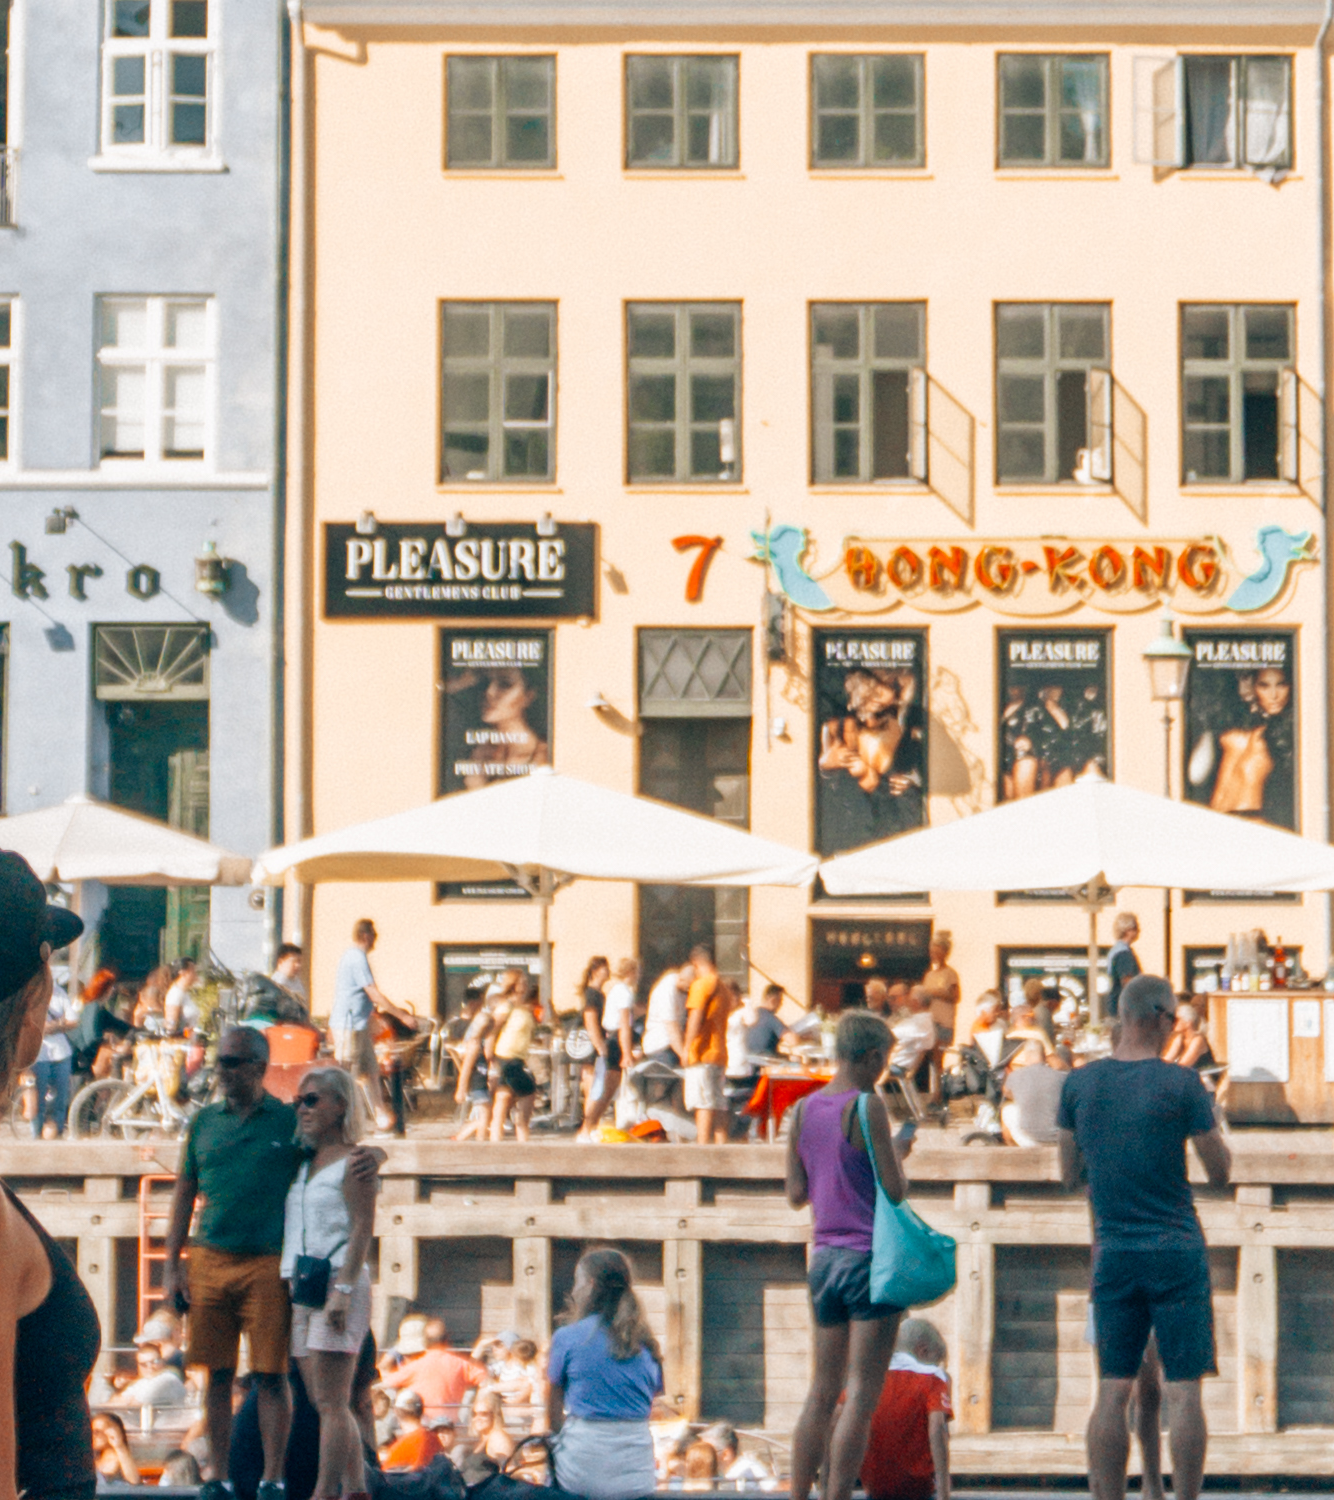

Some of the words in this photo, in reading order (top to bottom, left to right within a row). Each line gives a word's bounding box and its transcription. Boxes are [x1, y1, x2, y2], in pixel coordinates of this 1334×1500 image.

[345, 538, 566, 580] PLEASURE
[671, 535, 723, 603] 7
[844, 543, 1222, 595] HONG-KONG
[384, 585, 479, 600] GENTLEMENS
[481, 585, 521, 600] CLUB
[451, 639, 542, 660] PLEASURE
[825, 640, 917, 660] PLEASURE
[1009, 640, 1100, 661] PLEASURE
[1195, 640, 1286, 662] PLEASURE
[465, 731, 489, 745] LAP
[489, 731, 528, 745] DANCE
[454, 761, 504, 776] PRIVATE
